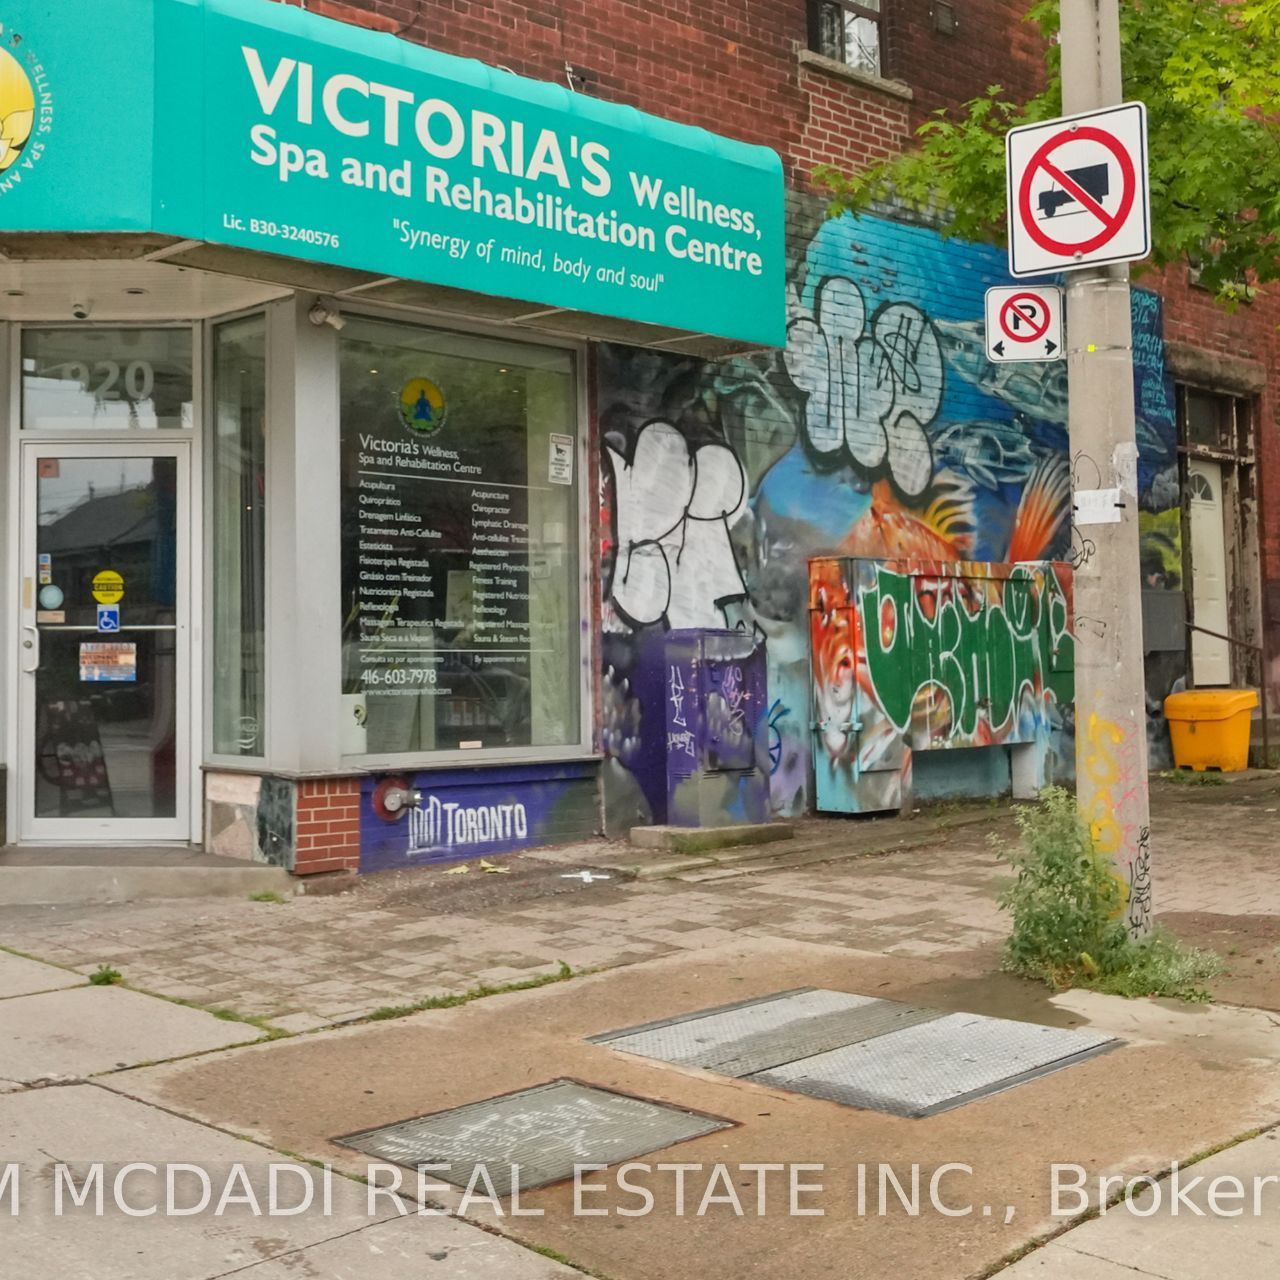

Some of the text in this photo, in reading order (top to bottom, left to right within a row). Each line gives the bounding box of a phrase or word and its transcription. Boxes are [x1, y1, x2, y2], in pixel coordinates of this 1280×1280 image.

[241, 46, 611, 197] VICTORIA'S
[22, 142, 45, 169] SPA
[250, 125, 763, 277] Spa and Rehabilitation Centre
[629, 171, 762, 241] Wellness,
[223, 213, 340, 250] Lic. B30-3240576
[393, 218, 664, 294] "Synergy of mind, body and soul"
[359, 433, 420, 455] Victoria's
[359, 452, 482, 475] Spa and Rehabilitation Centre
[471, 489, 509, 500] Acupuncture
[471, 503, 511, 515] Chiropractor
[471, 518, 502, 529] Lymphatic
[360, 669, 437, 684] 416-603-7978
